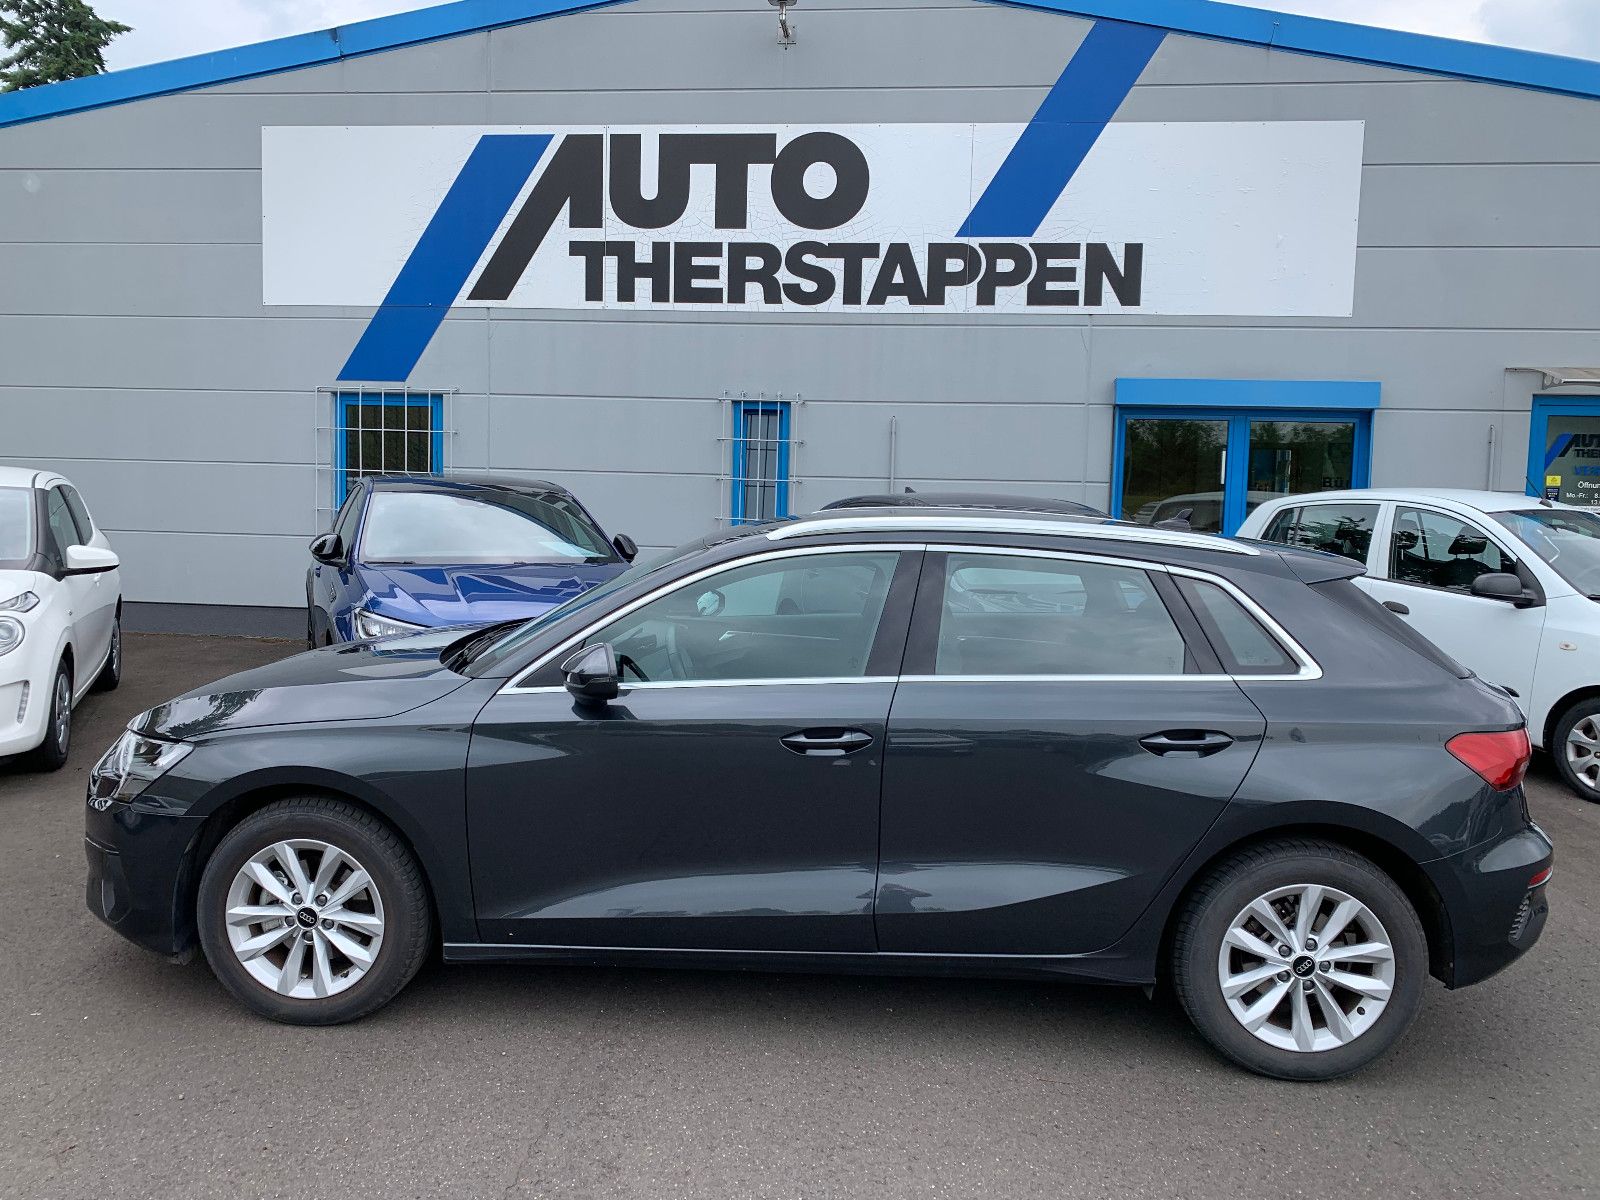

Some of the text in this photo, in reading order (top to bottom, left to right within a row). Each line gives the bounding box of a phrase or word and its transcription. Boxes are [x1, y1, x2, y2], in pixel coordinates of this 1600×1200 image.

[466, 131, 870, 301] AUTO
[568, 241, 1144, 307] THERSTAPPEN
[1574, 448, 1600, 458] THE
